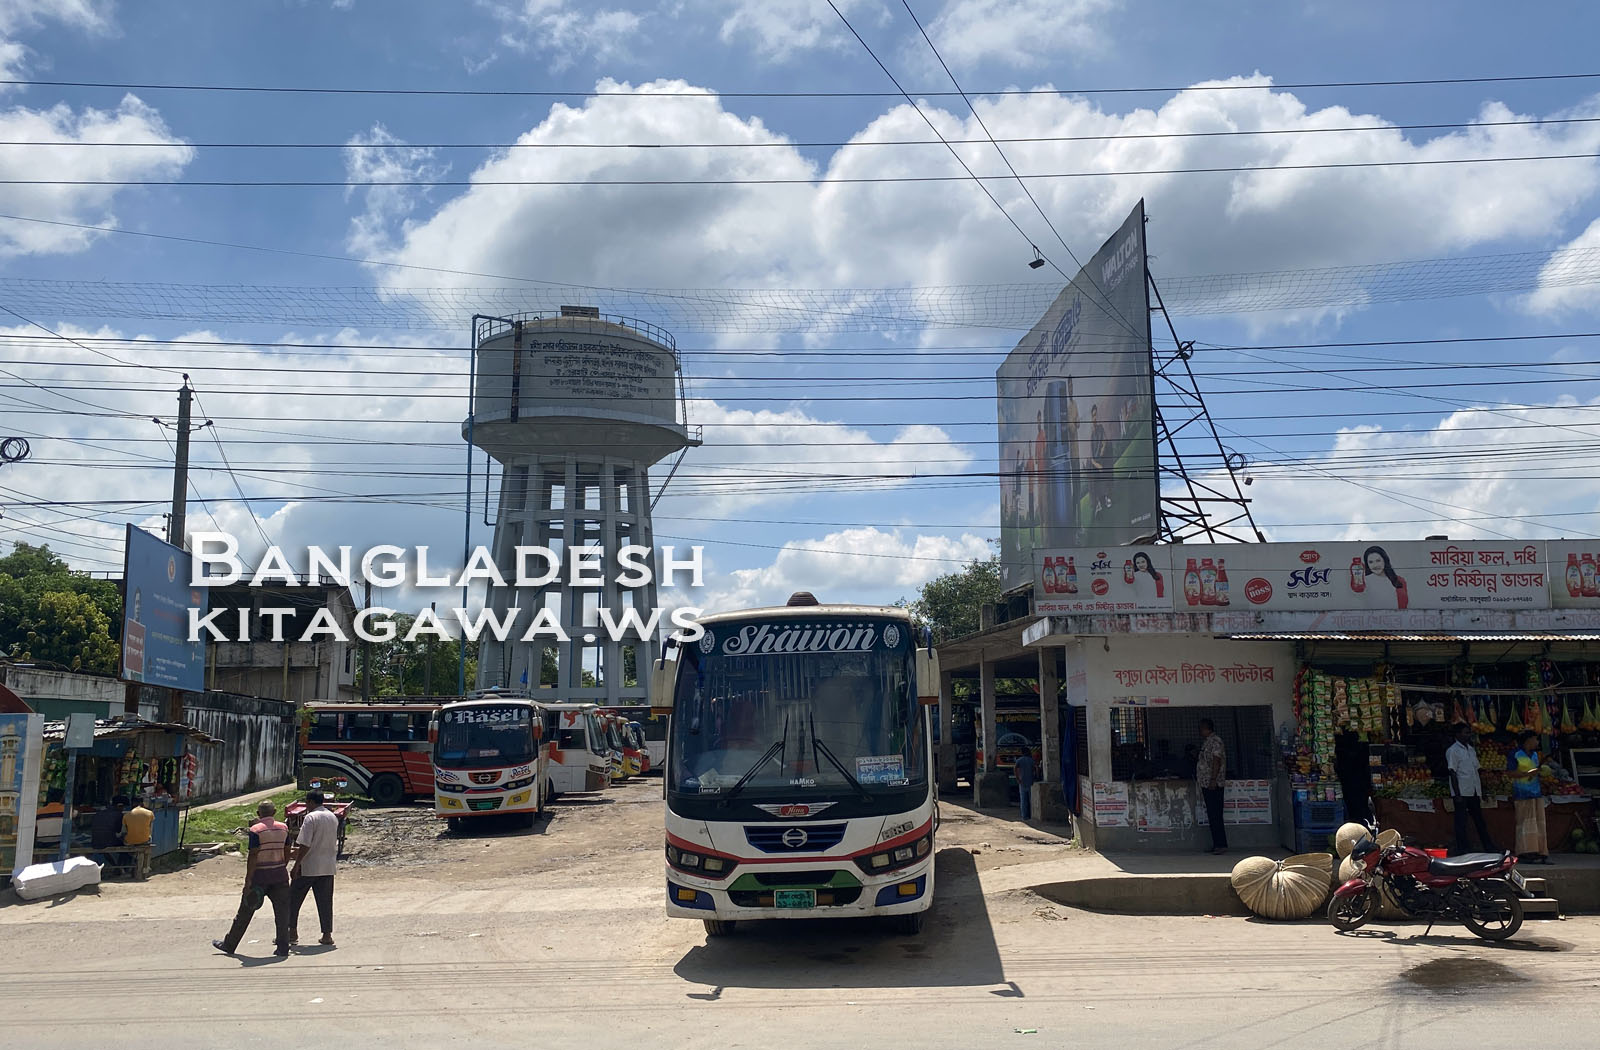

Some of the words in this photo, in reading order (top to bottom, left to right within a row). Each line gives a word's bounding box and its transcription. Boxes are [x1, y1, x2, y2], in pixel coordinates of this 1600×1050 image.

[1102, 227, 1138, 285] WALTON
[1430, 546, 1474, 566] মারিয়া
[1477, 551, 1510, 566] ফল,
[1513, 546, 1537, 565] দধি
[1249, 585, 1271, 599] BOSS
[1453, 568, 1497, 592] মিষ্টান্ন
[722, 624, 877, 653] Shawon
[1113, 669, 1143, 688] বগুড়া
[1144, 665, 1179, 685] মেইল
[1181, 663, 1217, 684] টিকিট
[1219, 662, 1276, 683] কাউন্টার
[455, 708, 519, 724] Rasel
